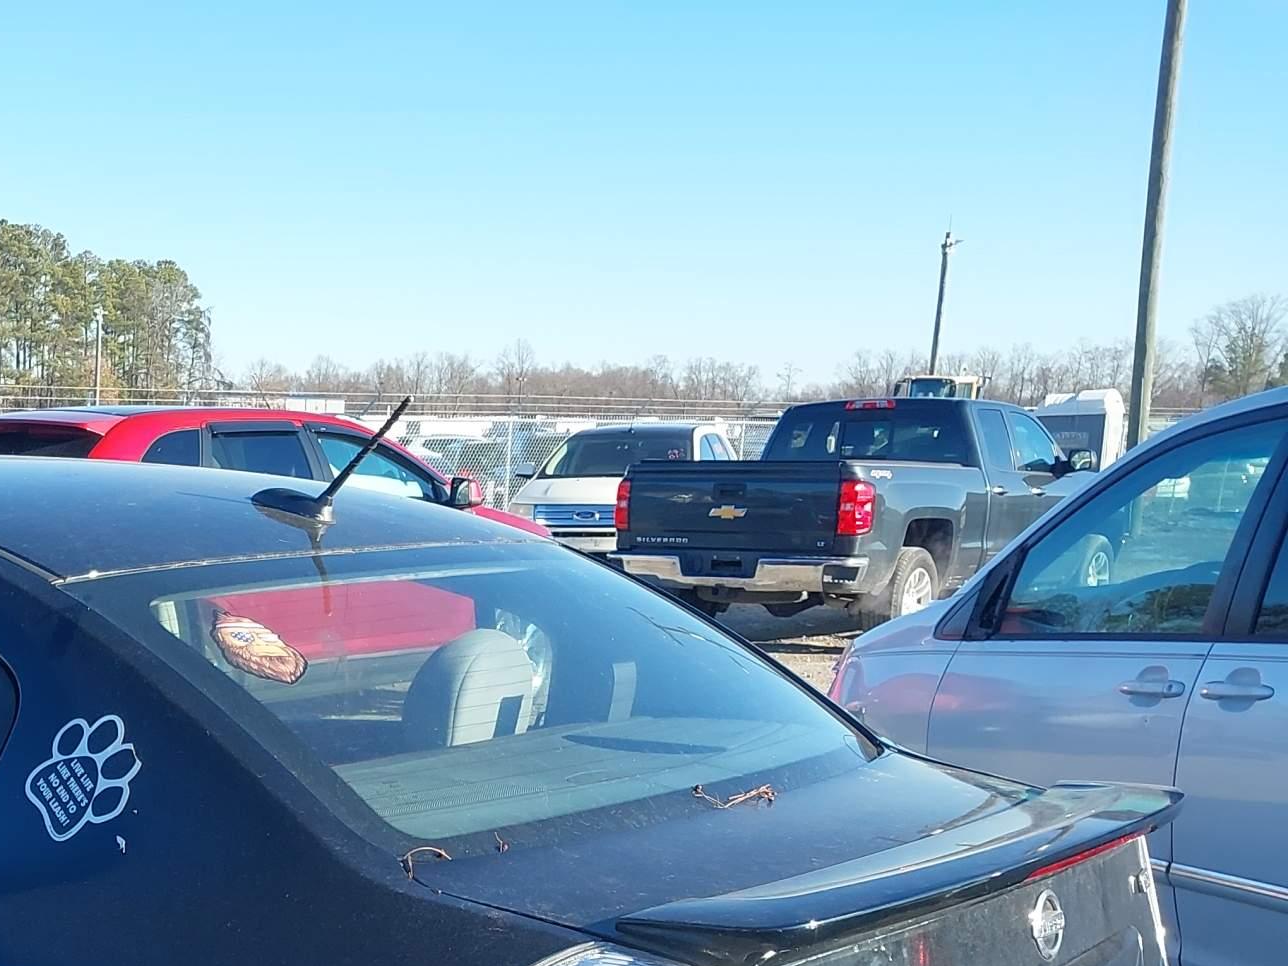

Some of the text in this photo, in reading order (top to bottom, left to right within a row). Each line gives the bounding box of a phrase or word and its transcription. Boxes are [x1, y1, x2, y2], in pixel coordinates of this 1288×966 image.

[57, 761, 71, 780] LIKE
[71, 759, 94, 791] LIVE LIFE
[37, 778, 53, 801] YOUR
[48, 773, 77, 813] NO END TO
